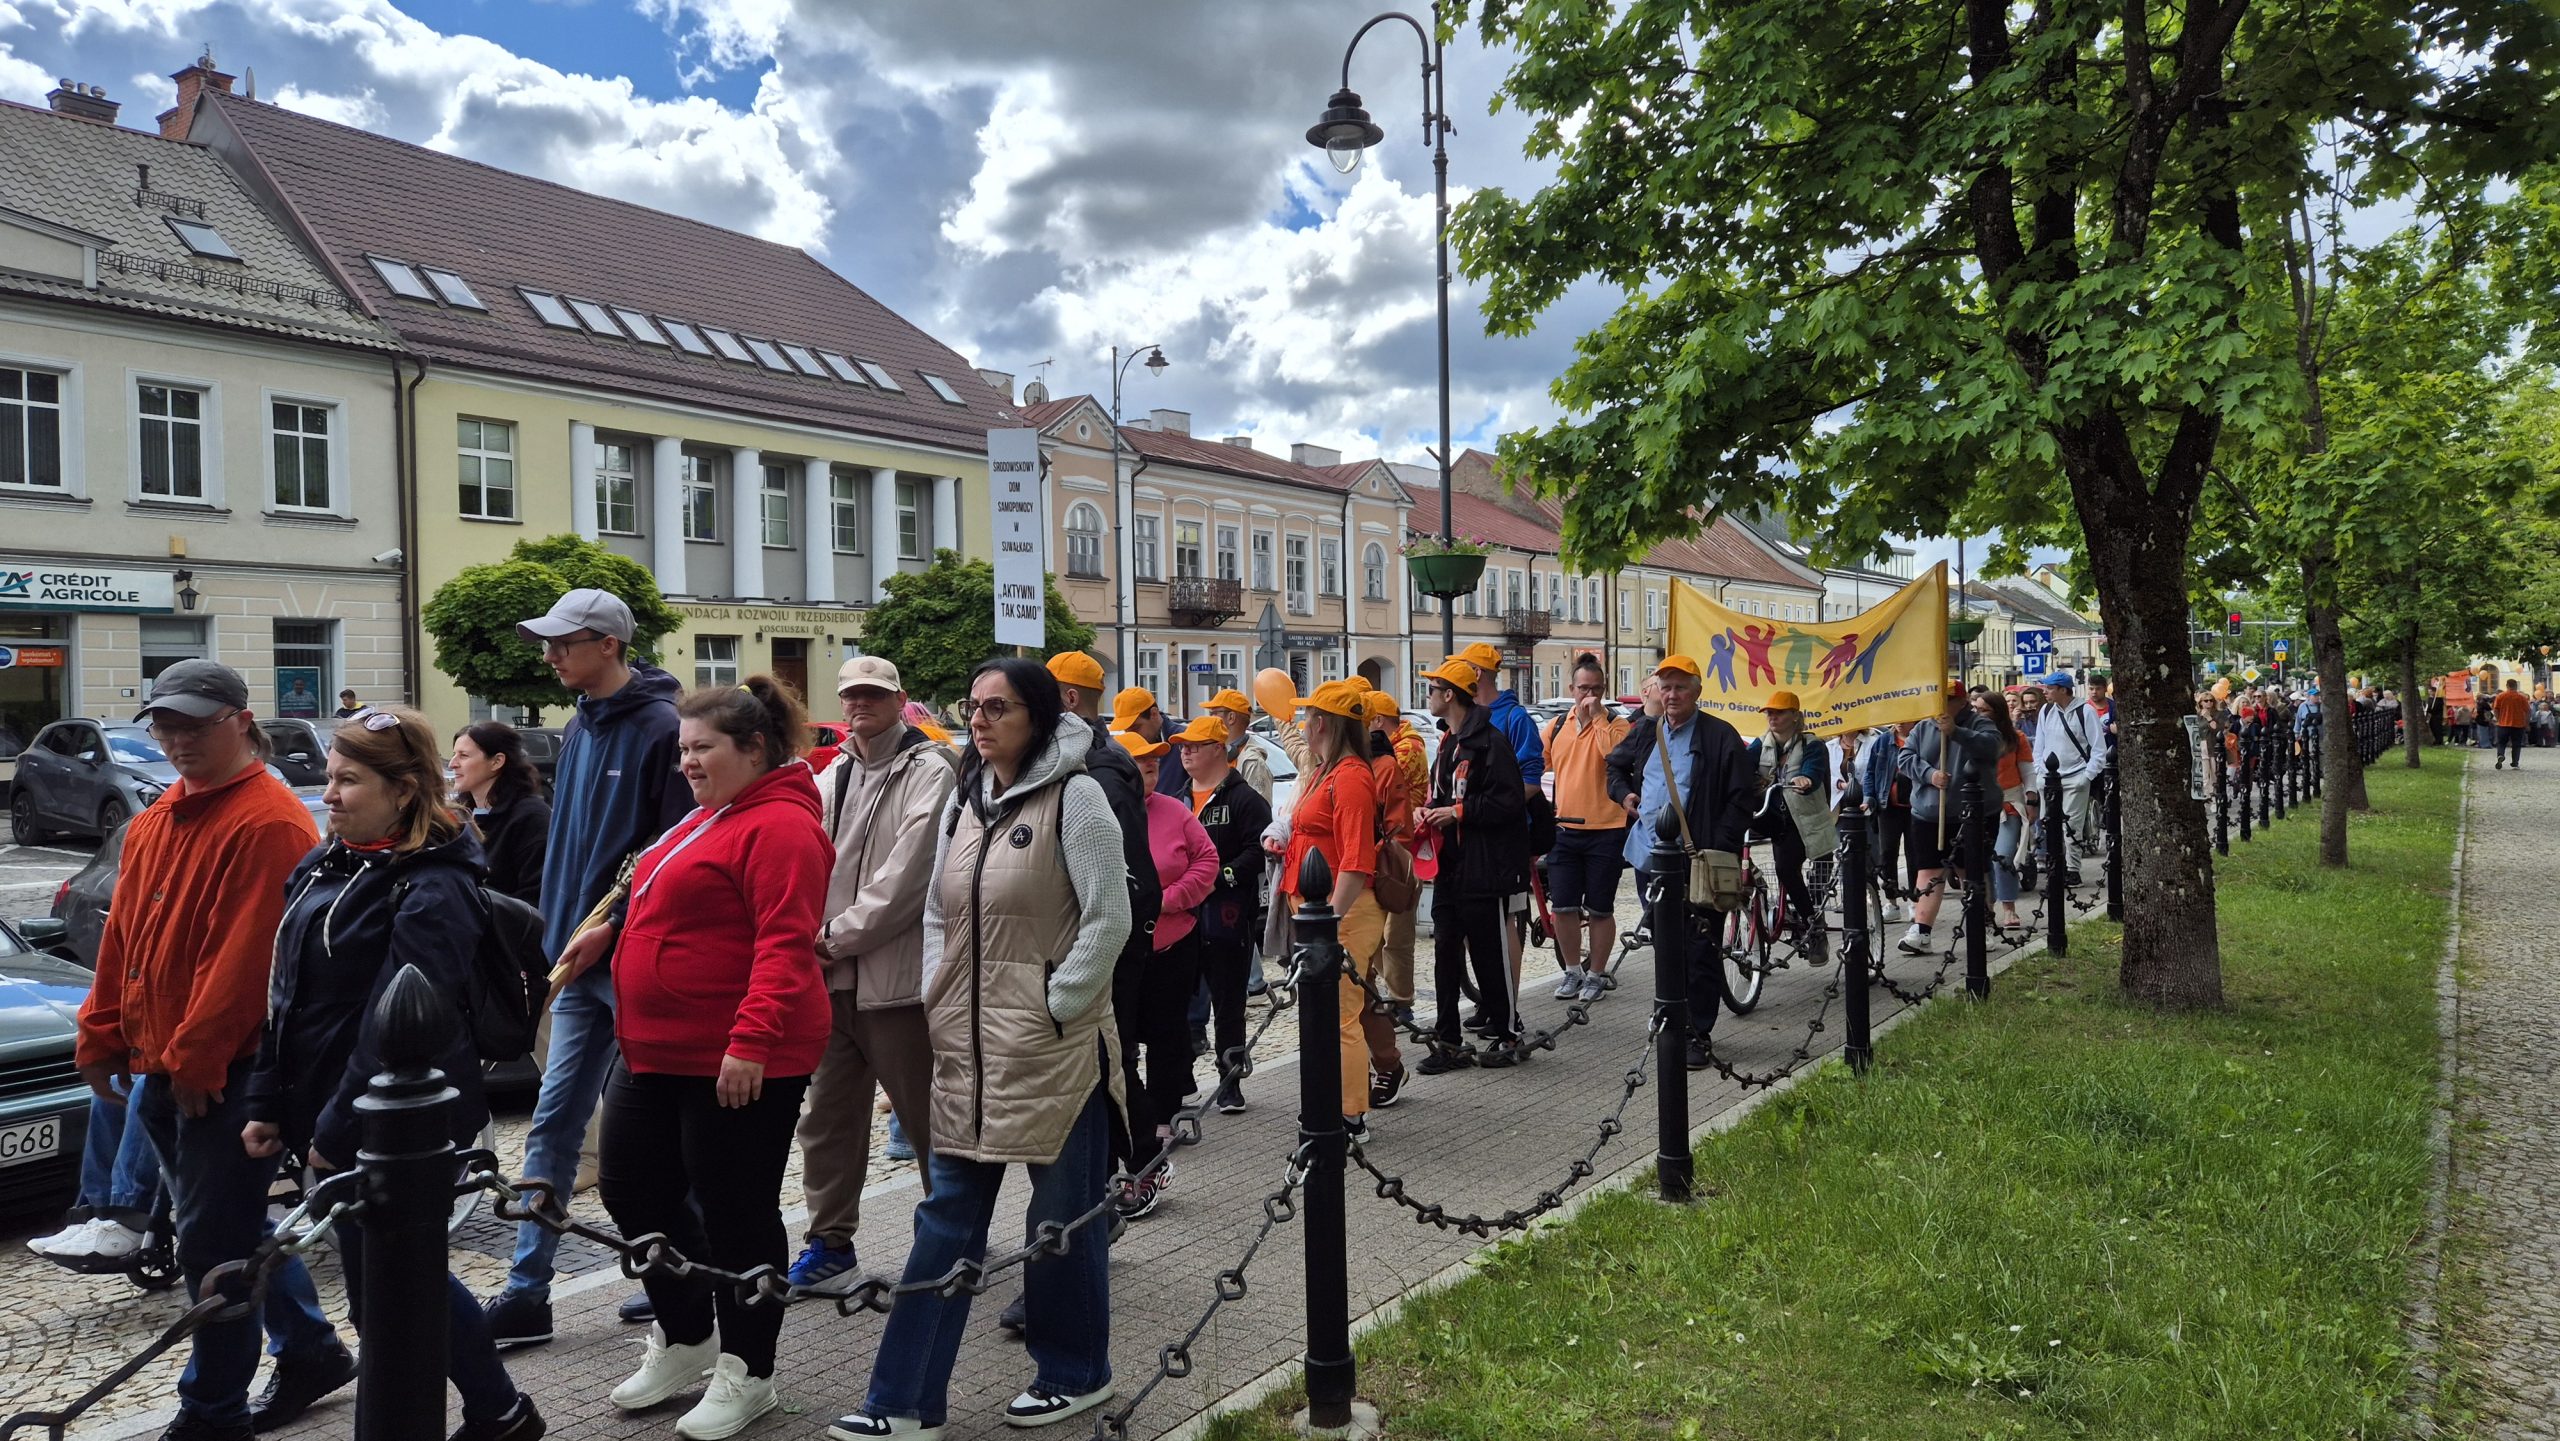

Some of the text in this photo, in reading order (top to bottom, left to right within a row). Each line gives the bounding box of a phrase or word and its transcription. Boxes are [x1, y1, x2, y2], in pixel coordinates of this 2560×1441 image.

[993, 460, 1035, 472] ŚRODOWISKOWY
[1008, 481, 1020, 492] DOM
[997, 501, 1034, 513] SAMOPOMOCY
[1013, 522, 1019, 532] W
[1001, 541, 1034, 553] SUWAŁKACH
[40, 573, 112, 587] CRÉDIT
[40, 588, 140, 602] AGRICOLE
[669, 606, 730, 620] NDACJA
[737, 608, 789, 622] ROZWOJU
[1001, 603, 1015, 618] TAK
[813, 625, 825, 635] 62
[2028, 656, 2040, 672] P
[1831, 686, 1921, 711] Wychowawczy
[1926, 684, 1939, 693] nr
